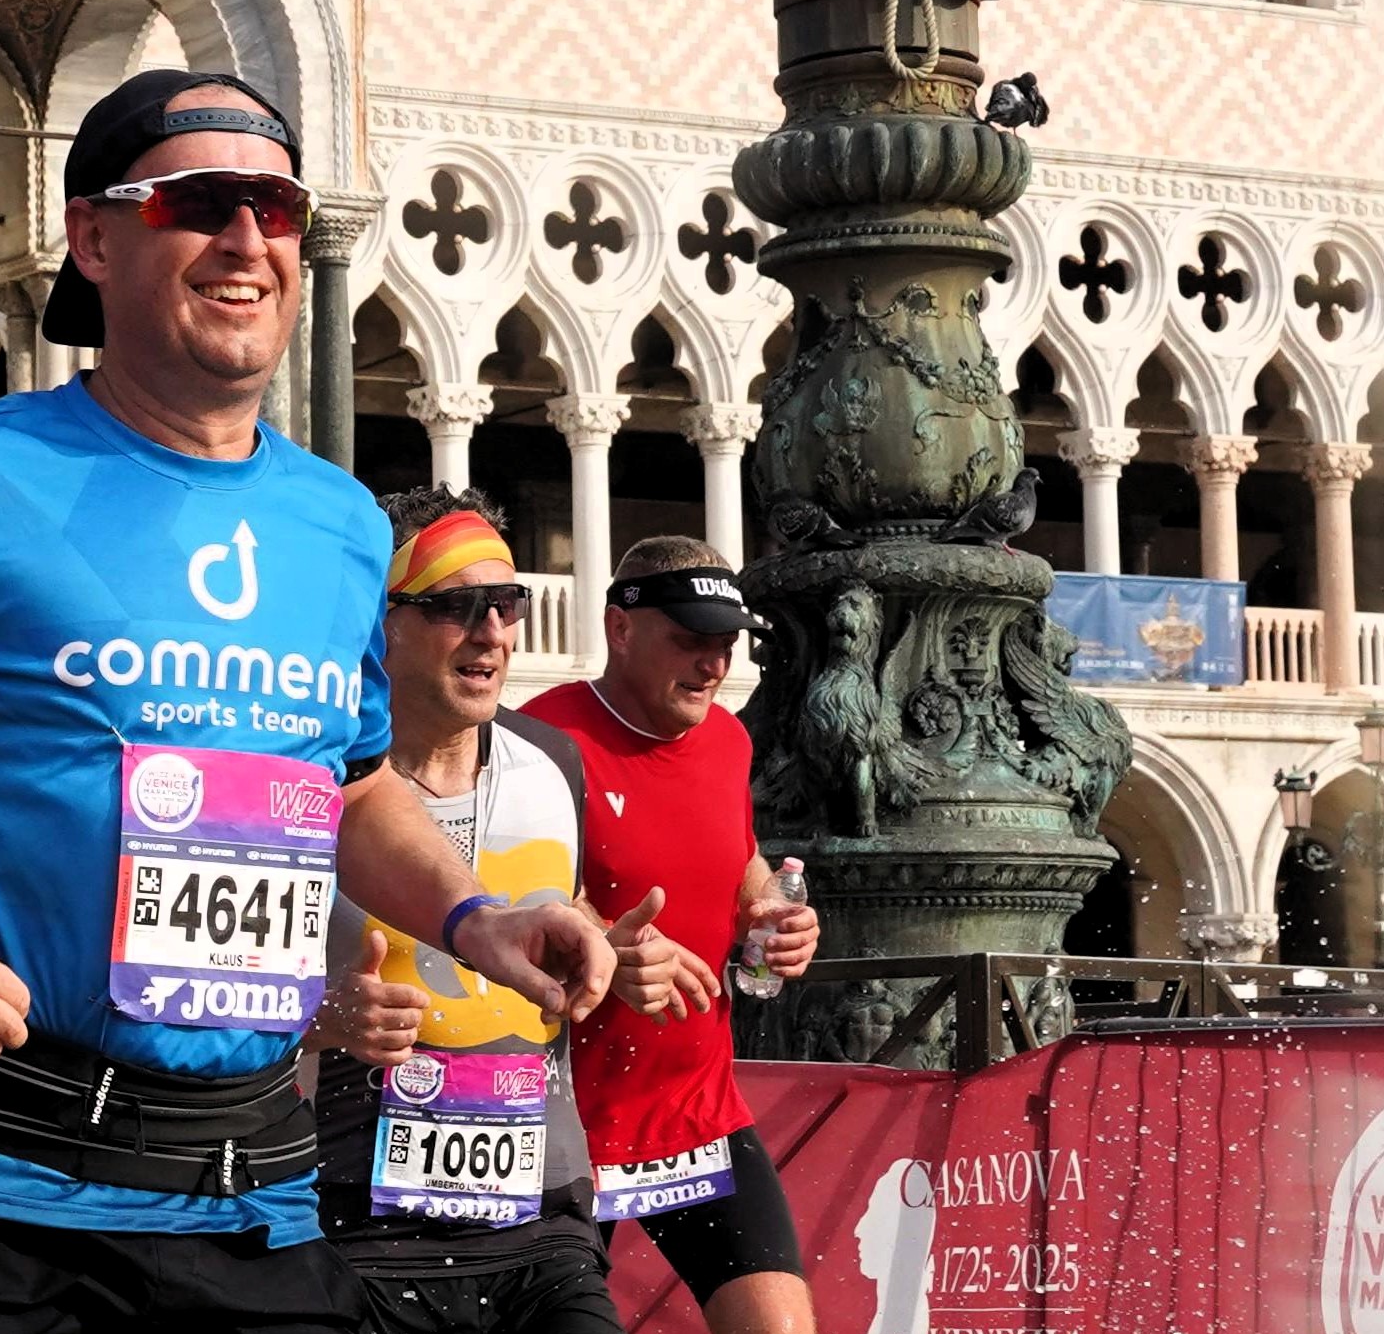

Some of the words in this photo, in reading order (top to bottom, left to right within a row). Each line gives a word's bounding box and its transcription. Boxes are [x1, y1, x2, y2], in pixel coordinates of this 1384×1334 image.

[141, 697, 237, 731] sports
[249, 701, 322, 739] team
[144, 778, 189, 791] VENICE
[169, 873, 295, 949] 4641
[209, 952, 243, 967] KLAUS
[421, 1130, 515, 1179] 1060
[425, 1178, 465, 1190] UMBERTO
[900, 1148, 1085, 1208] CASANOVA
[941, 1243, 1079, 1293] 1725-2025
